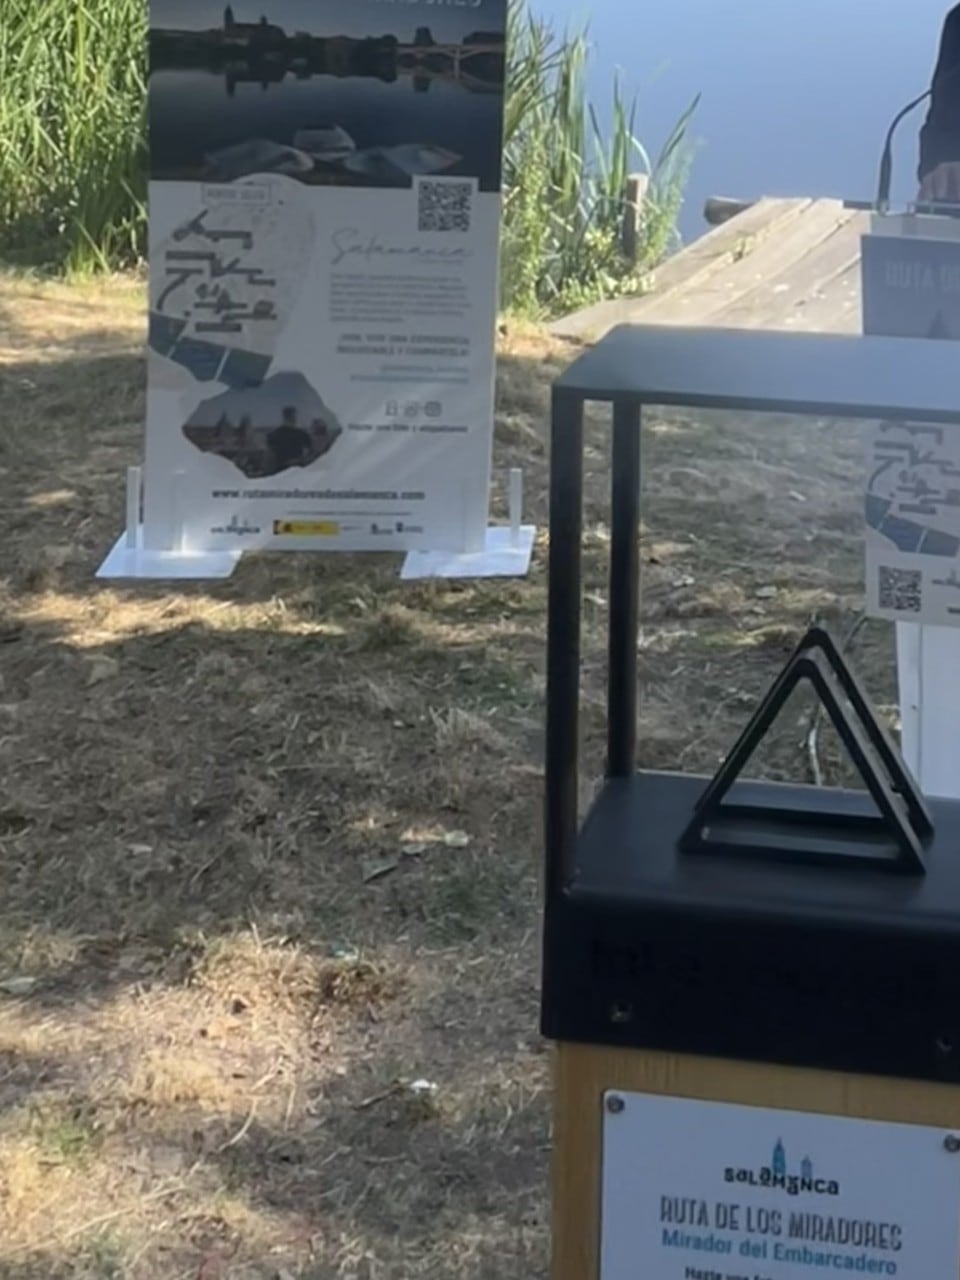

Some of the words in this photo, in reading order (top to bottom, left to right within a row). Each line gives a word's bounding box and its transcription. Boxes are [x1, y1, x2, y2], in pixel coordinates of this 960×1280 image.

[660, 1195, 709, 1227] RUTA
[715, 1202, 740, 1231] DE
[746, 1206, 783, 1237] LOS
[788, 1212, 903, 1251] MIRADORES
[661, 1228, 732, 1255] Mirador
[738, 1239, 768, 1261] del
[773, 1242, 898, 1276] Embarcadero
